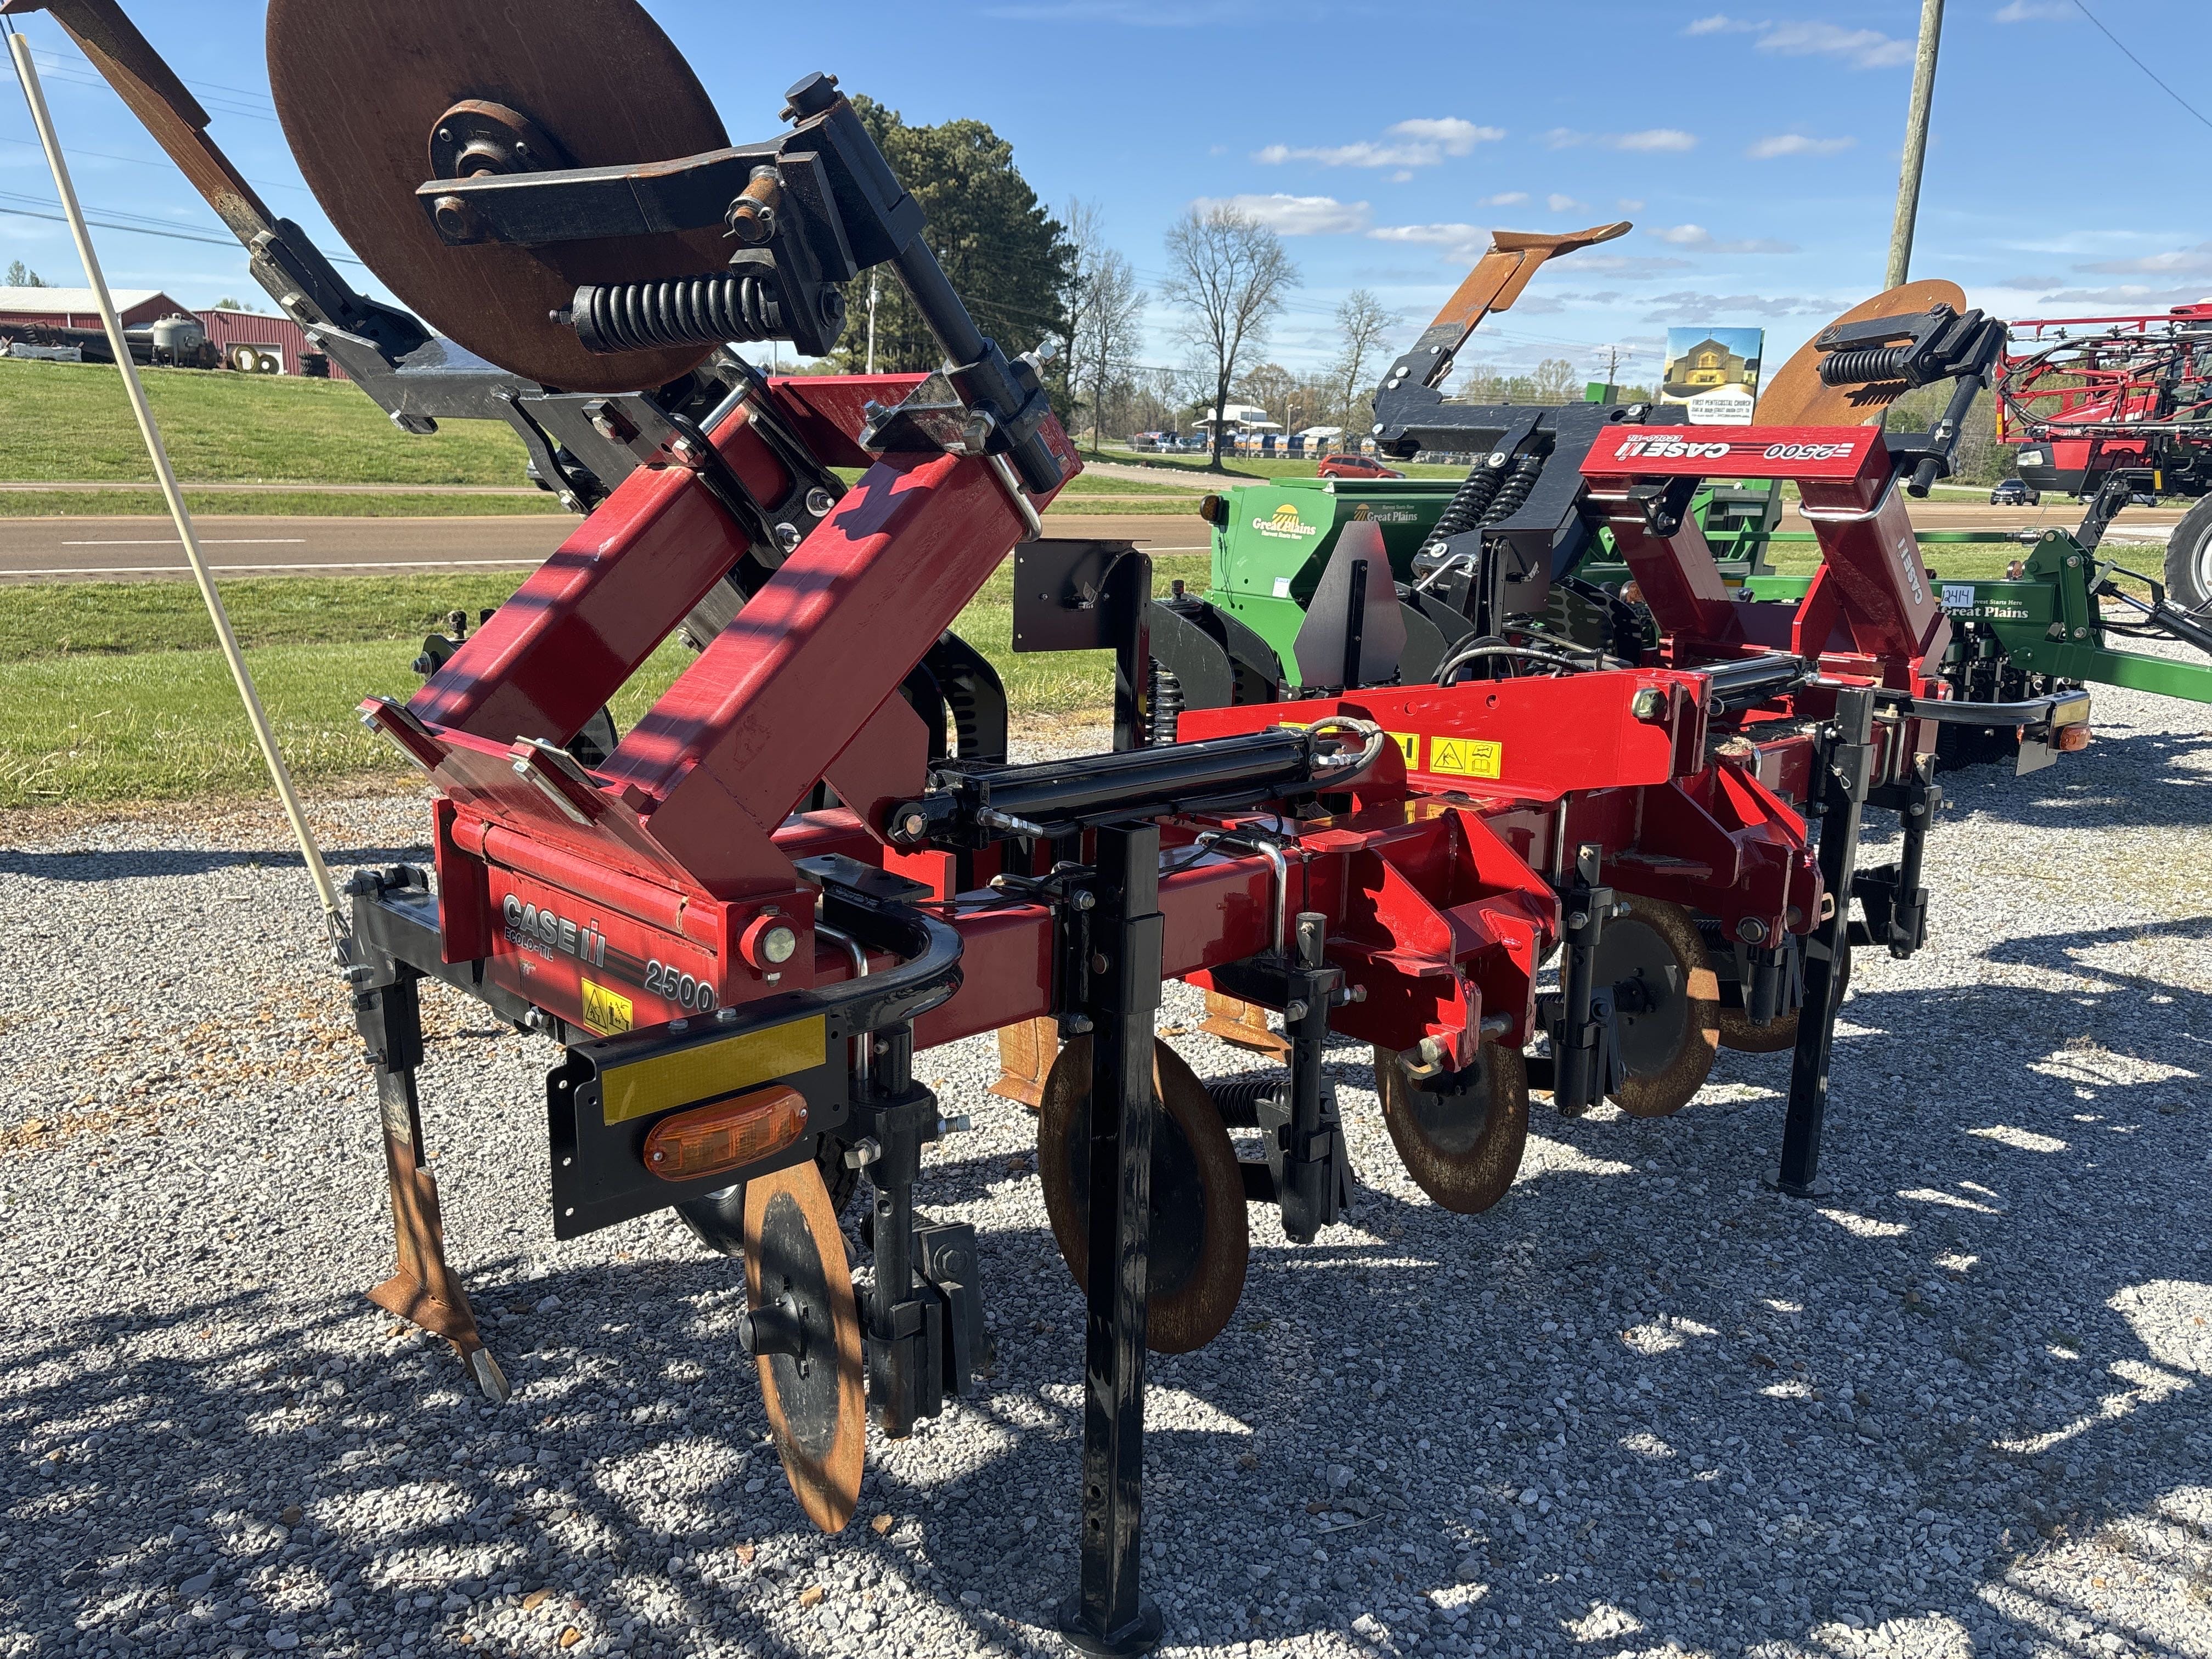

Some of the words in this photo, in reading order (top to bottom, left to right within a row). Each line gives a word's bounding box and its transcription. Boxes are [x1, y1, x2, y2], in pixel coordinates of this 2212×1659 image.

[1645, 442, 1730, 458] CASE
[1763, 444, 1840, 460] 2500
[1367, 512, 1391, 521] Great
[1392, 511, 1418, 521] Plains
[1252, 517, 1282, 532] Great
[1282, 521, 1317, 535] Plains
[1903, 554, 1923, 605] CASE
[1942, 589, 1970, 605] 12414
[1940, 606, 1982, 617] Great
[1984, 606, 2029, 618] Plains
[504, 926, 554, 962] ECOLO-TIL
[503, 892, 578, 955] CASE
[645, 958, 714, 1013] 2500
